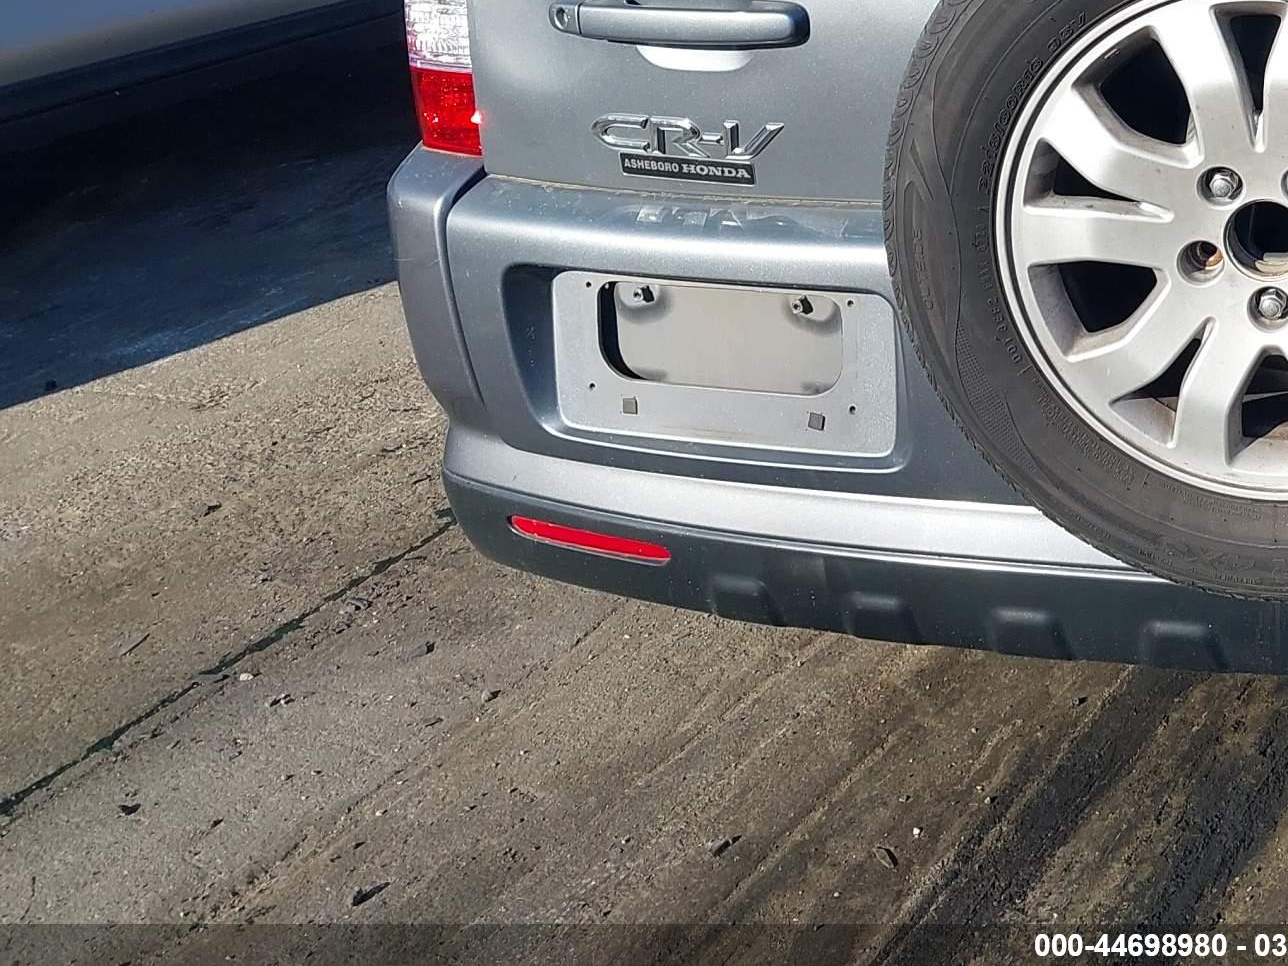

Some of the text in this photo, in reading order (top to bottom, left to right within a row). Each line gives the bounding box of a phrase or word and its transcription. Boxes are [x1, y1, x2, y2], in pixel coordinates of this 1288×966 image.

[591, 113, 785, 160] CR-V
[623, 158, 752, 179] ASHEBORO HONDA
